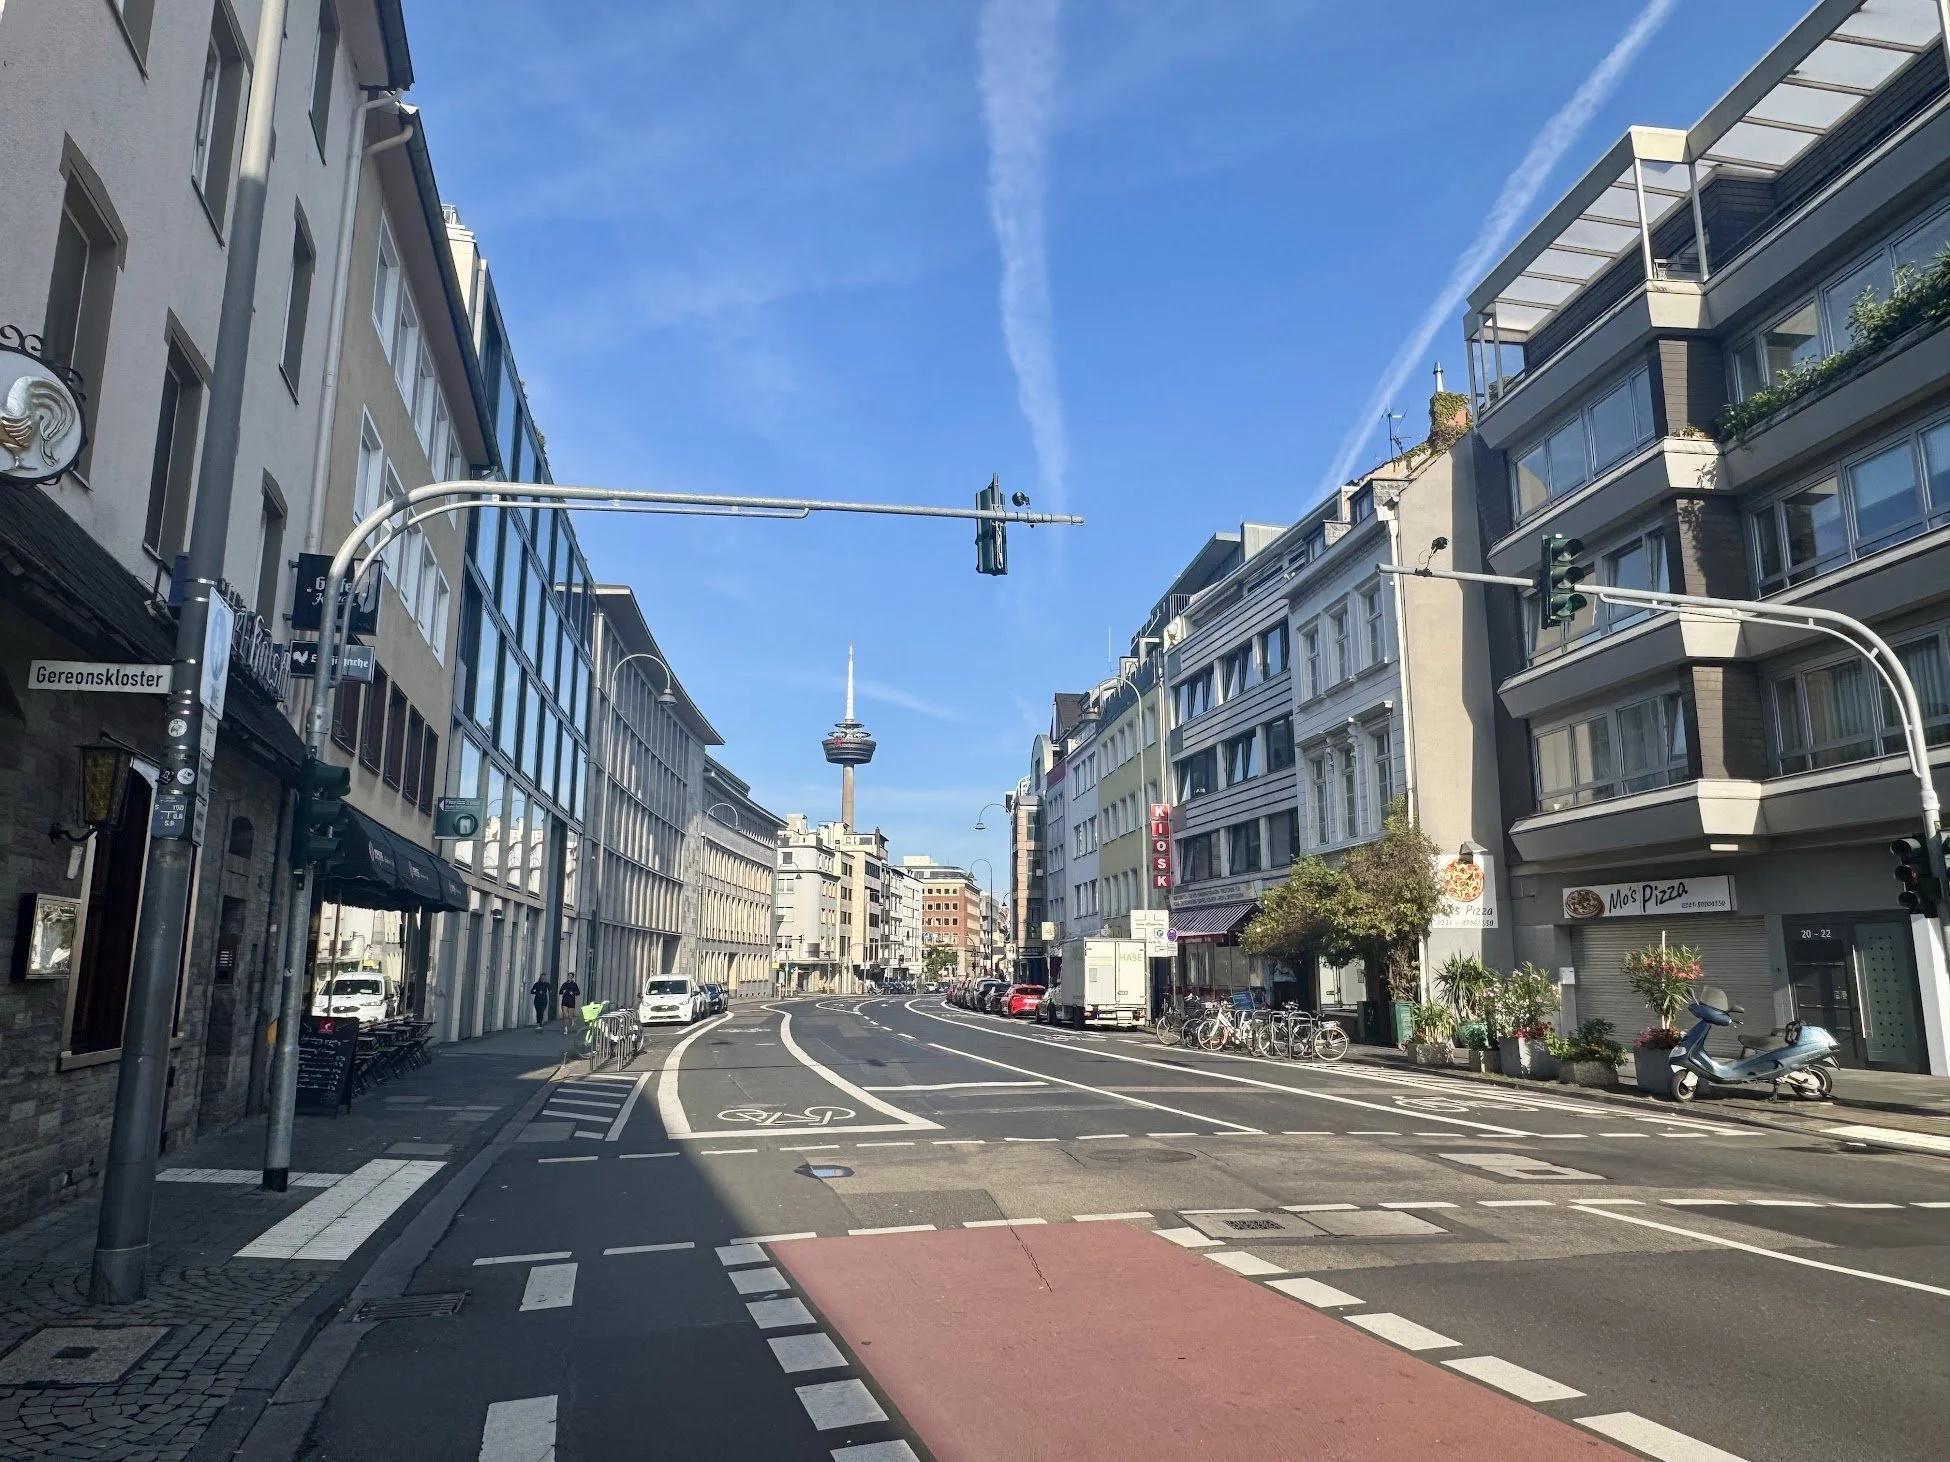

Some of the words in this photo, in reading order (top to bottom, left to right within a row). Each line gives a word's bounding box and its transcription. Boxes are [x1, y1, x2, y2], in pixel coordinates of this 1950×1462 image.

[36, 665, 163, 688] Gereonskloster
[1155, 805, 1168, 887] KIOSK
[1609, 886, 1637, 914] Mo's
[1641, 881, 1689, 912] Pizza
[1801, 929, 1812, 939] 20
[1820, 929, 1832, 938] 22
